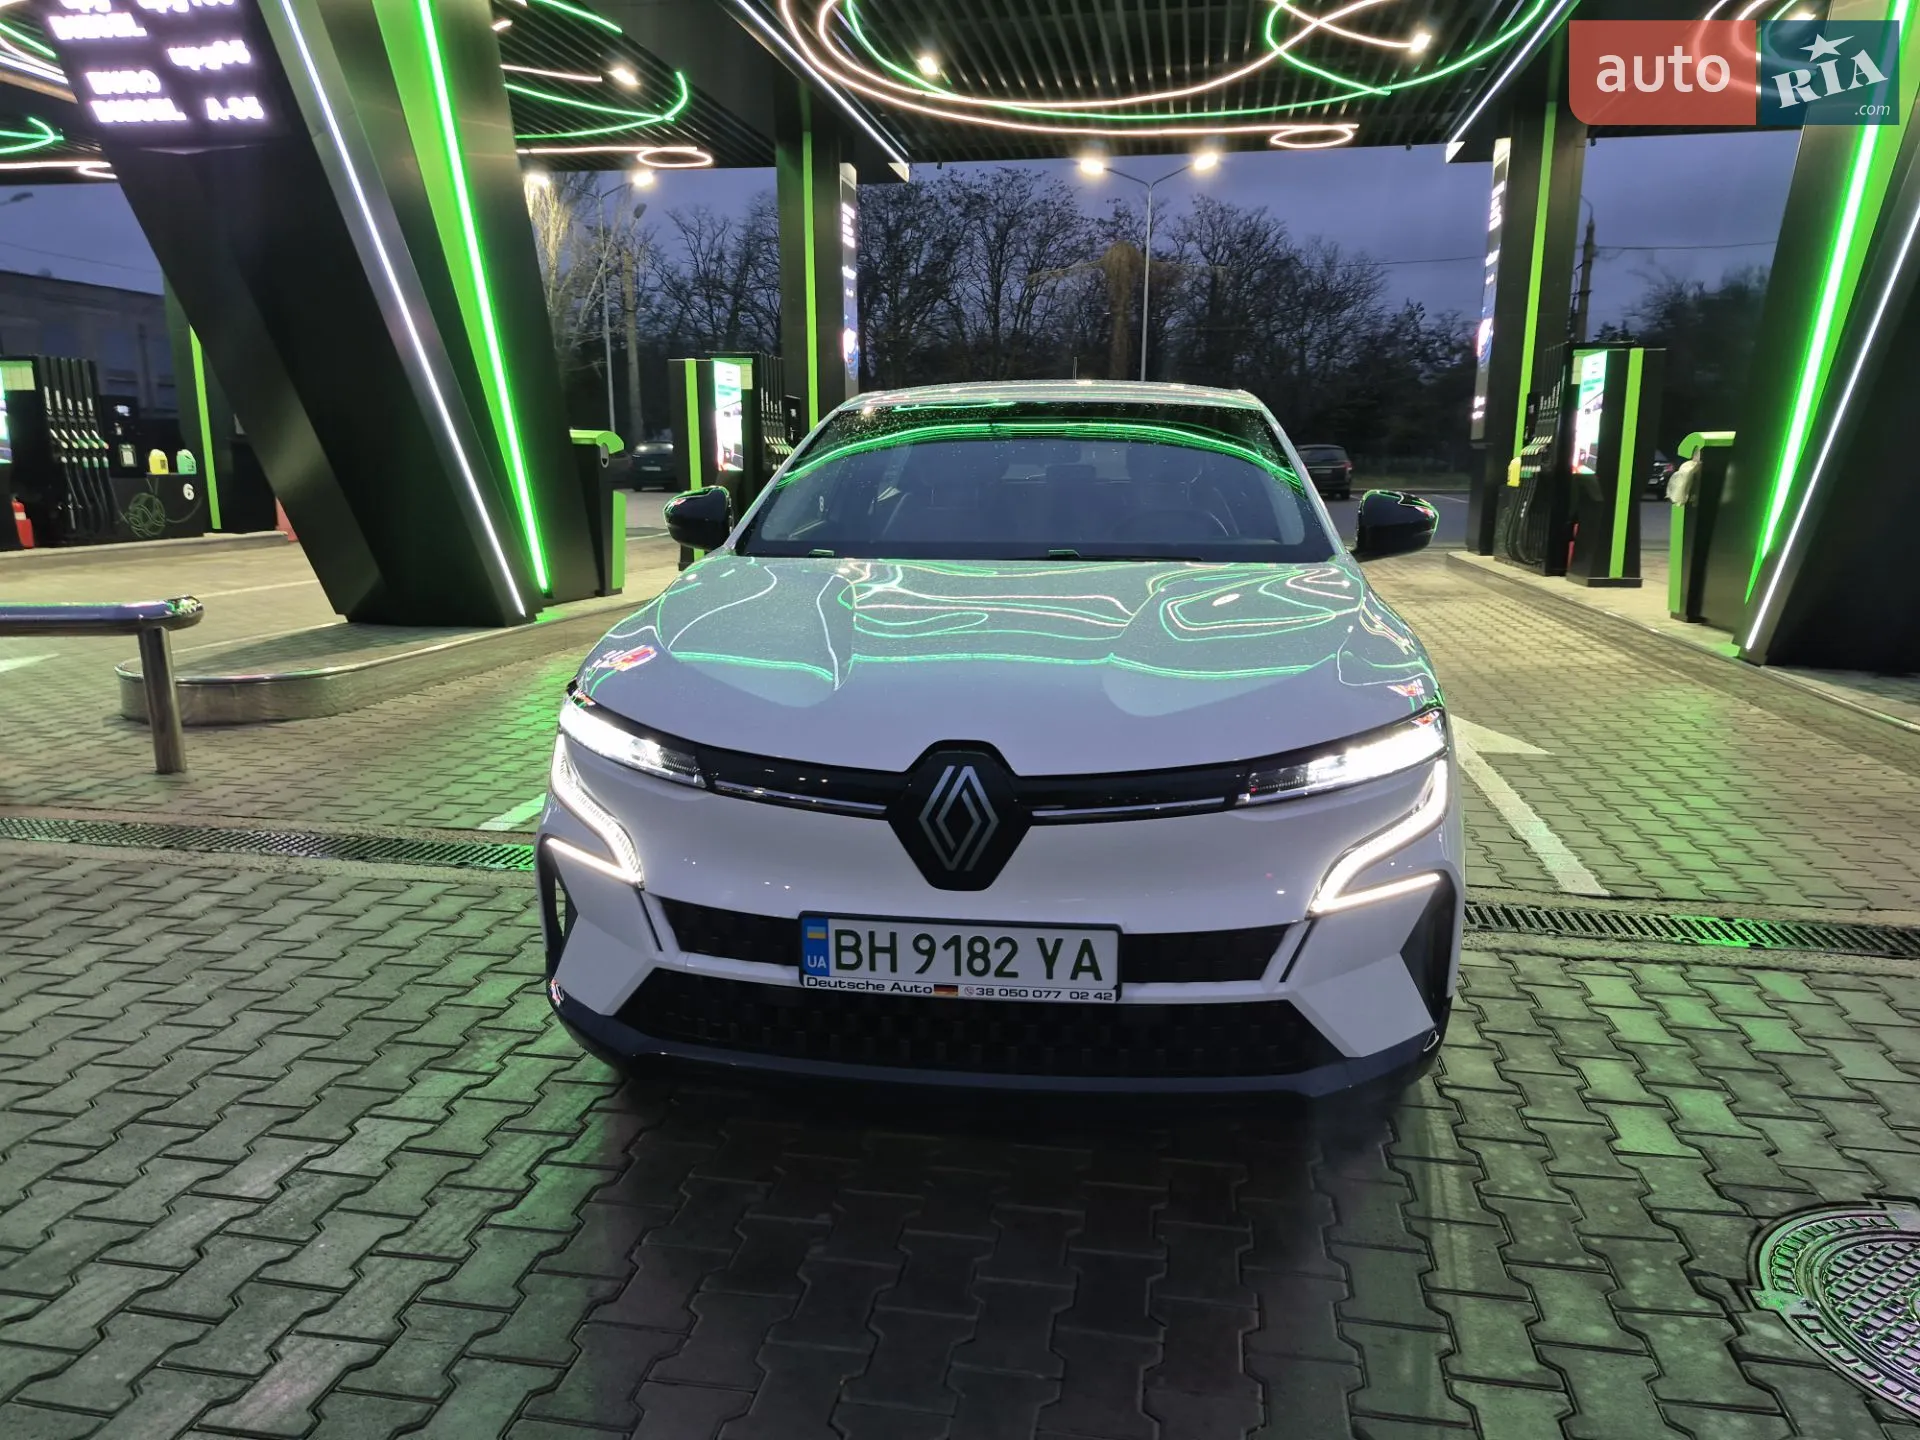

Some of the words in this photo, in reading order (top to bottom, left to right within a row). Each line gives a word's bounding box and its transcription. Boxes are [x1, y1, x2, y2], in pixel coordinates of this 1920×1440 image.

[183, 483, 194, 500] 6
[807, 955, 827, 969] UA
[834, 928, 898, 973] BH
[912, 933, 1019, 978] 9182
[1036, 937, 1102, 981] YA
[806, 976, 885, 992] Deutsche
[890, 982, 933, 994] Auto
[999, 988, 1028, 998] 050
[1032, 990, 1061, 999] 077
[1069, 991, 1089, 1000] 02
[1093, 992, 1113, 1001] 42
